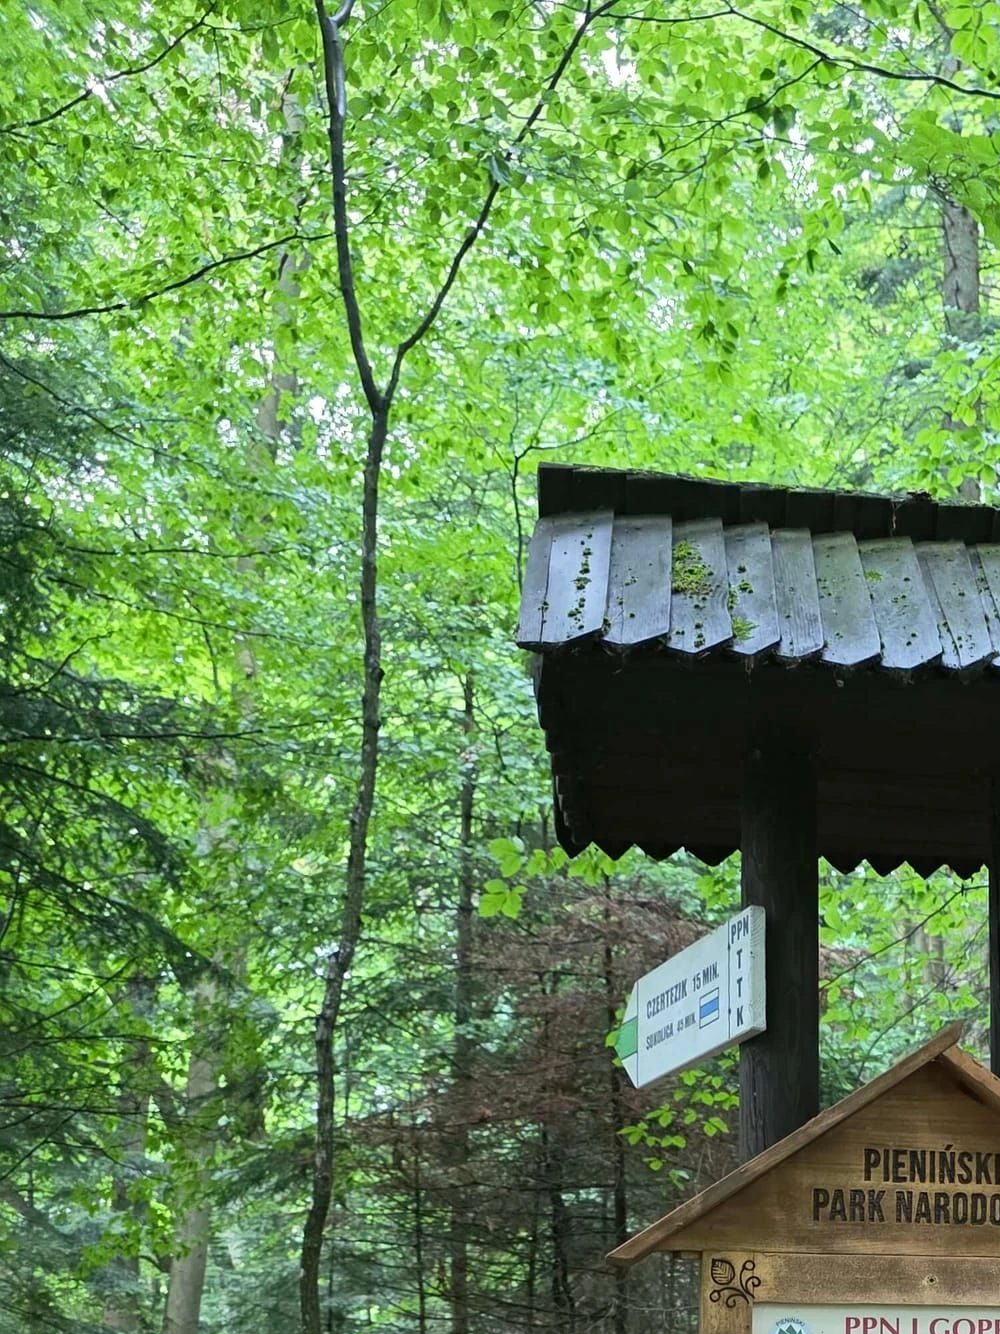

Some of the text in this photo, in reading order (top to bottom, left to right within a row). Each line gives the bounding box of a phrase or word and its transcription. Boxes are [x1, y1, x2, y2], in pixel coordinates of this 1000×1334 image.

[731, 914, 749, 944] PPN
[692, 972, 701, 992] 15
[703, 962, 719, 986] MIN.
[646, 1023, 674, 1050] SOKOLICA
[863, 1144, 1000, 1185] PIENIŃSKI
[812, 1188, 886, 1222] PARK
